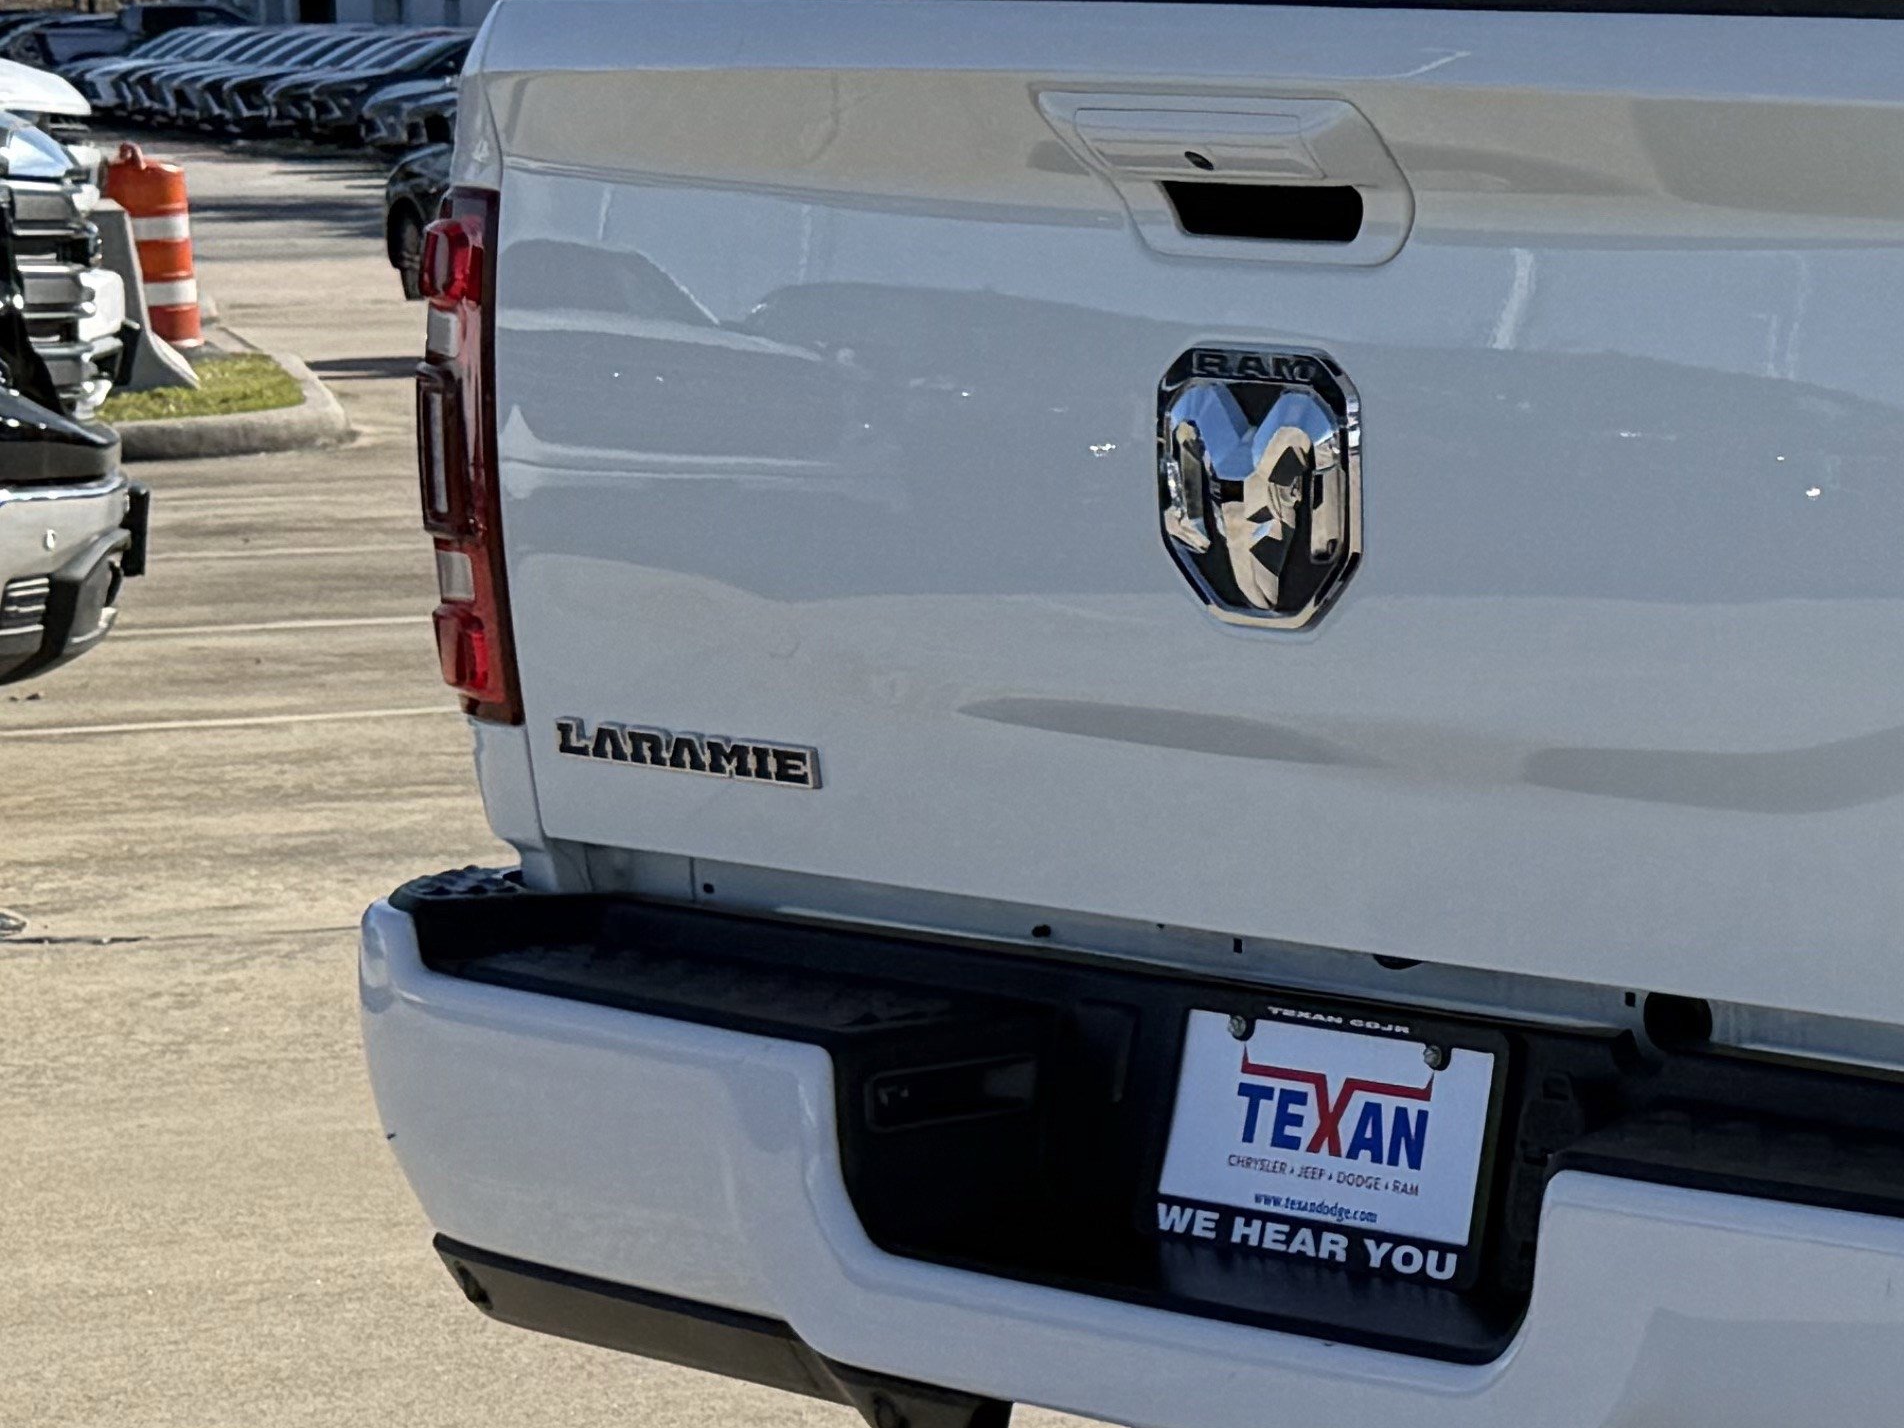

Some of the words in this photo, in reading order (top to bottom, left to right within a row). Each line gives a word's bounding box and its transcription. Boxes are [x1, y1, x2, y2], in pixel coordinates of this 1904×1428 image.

[1192, 350, 1318, 383] RAM
[555, 717, 823, 789] LARAMIE
[1267, 1005, 1343, 1024] TEXAN
[1237, 1062, 1433, 1171] TEXAN
[1228, 1154, 1287, 1175] CHRYSLER
[1297, 1165, 1325, 1181] JEEP
[1336, 1172, 1381, 1191] DODGE
[1392, 1180, 1420, 1197] RAM
[1254, 1193, 1378, 1223] www.texandodge.com
[1157, 1203, 1220, 1239] WE
[1230, 1216, 1349, 1263] HEAR
[1363, 1238, 1458, 1281] YOU
